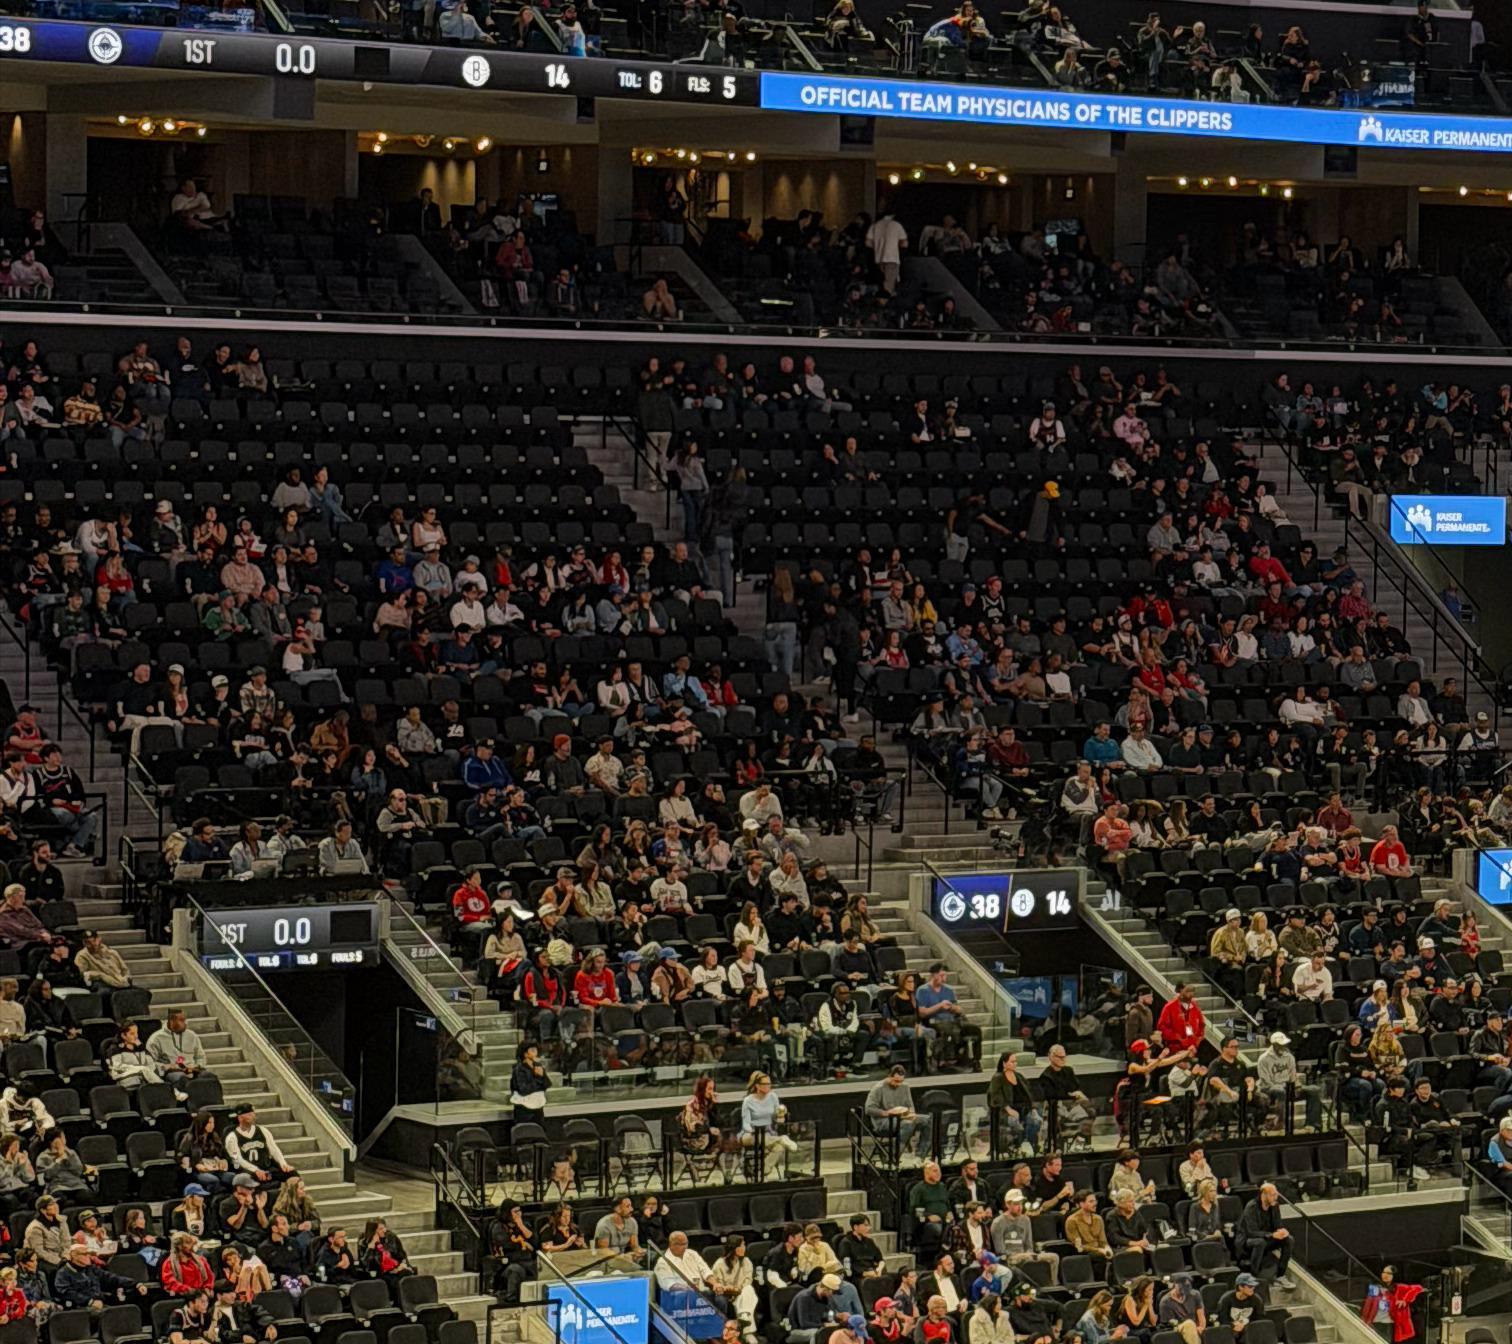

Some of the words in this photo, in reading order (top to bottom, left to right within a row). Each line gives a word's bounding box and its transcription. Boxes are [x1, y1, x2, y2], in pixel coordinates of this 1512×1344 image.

[0, 26, 31, 52] 38
[183, 40, 217, 64] 1ST
[275, 43, 316, 74] 0.0
[544, 64, 570, 88] 14
[648, 70, 663, 94] 6
[723, 76, 736, 99] 5
[800, 85, 893, 110] OFFICIAL
[898, 92, 952, 114] TEAM
[957, 95, 1070, 121] PHYSICIANS
[1074, 103, 1101, 122] OF
[1105, 105, 1142, 125] THE
[1146, 107, 1233, 131] CLIPPERS
[1385, 127, 1430, 145] KAISER
[970, 894, 1000, 919] 38
[1046, 891, 1071, 915] 14
[274, 918, 310, 945] 0.0
